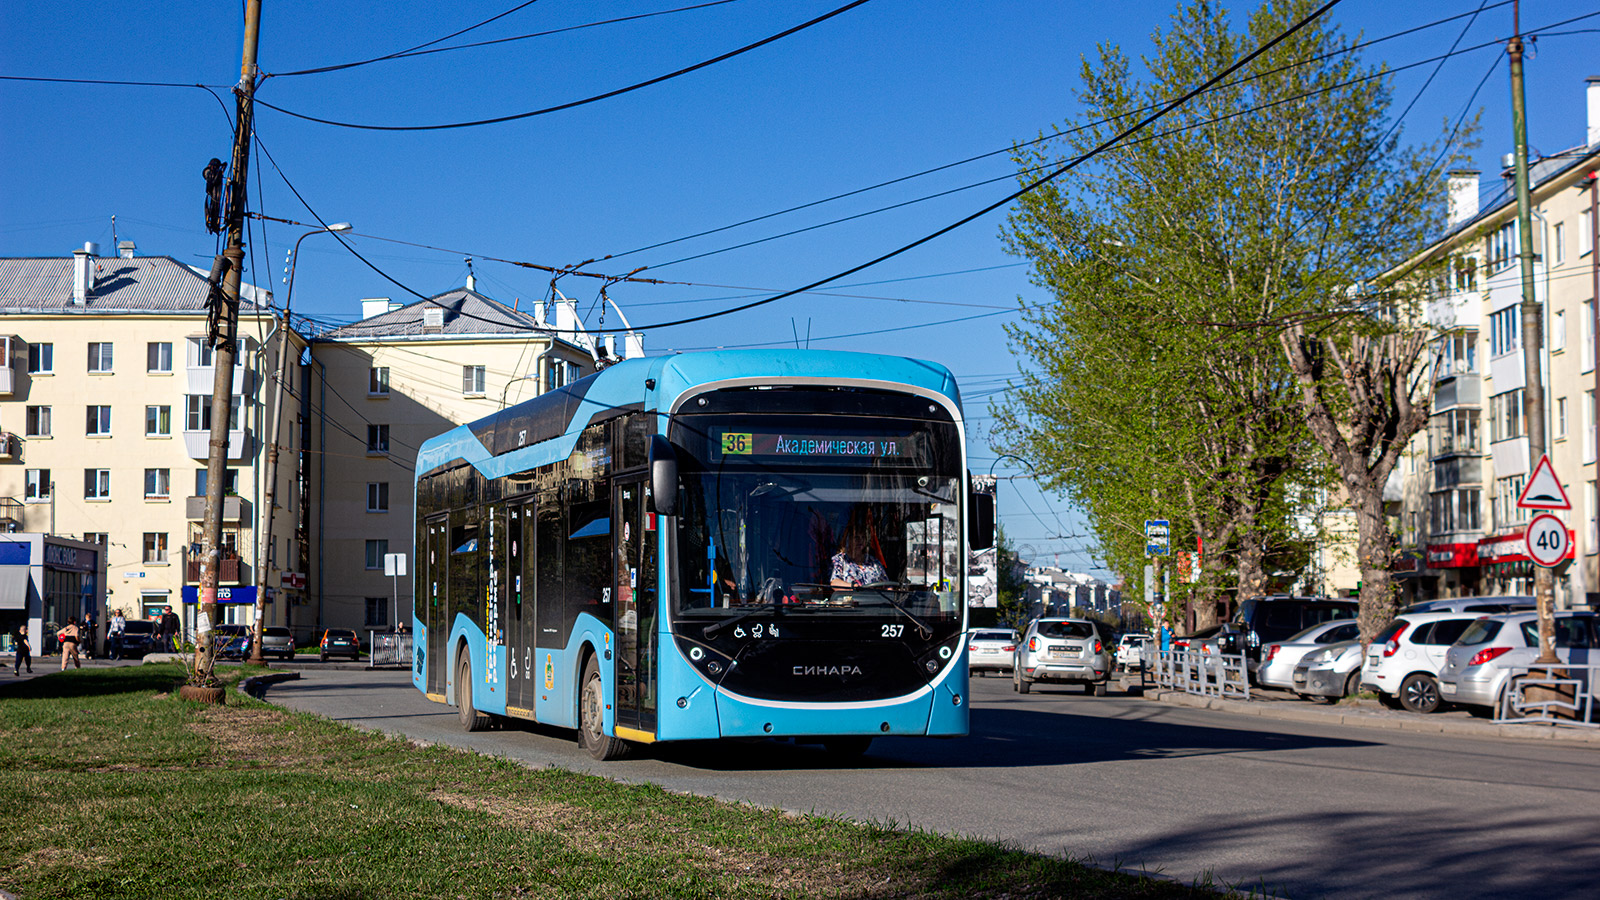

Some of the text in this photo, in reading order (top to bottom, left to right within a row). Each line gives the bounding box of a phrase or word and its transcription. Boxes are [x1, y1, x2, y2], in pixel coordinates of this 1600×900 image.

[726, 434, 745, 452] 36
[775, 435, 900, 457] Академическая ул.
[1537, 530, 1560, 550] 40
[602, 587, 611, 603] 257
[881, 624, 904, 638] 257
[792, 665, 863, 676] СИНАРА
